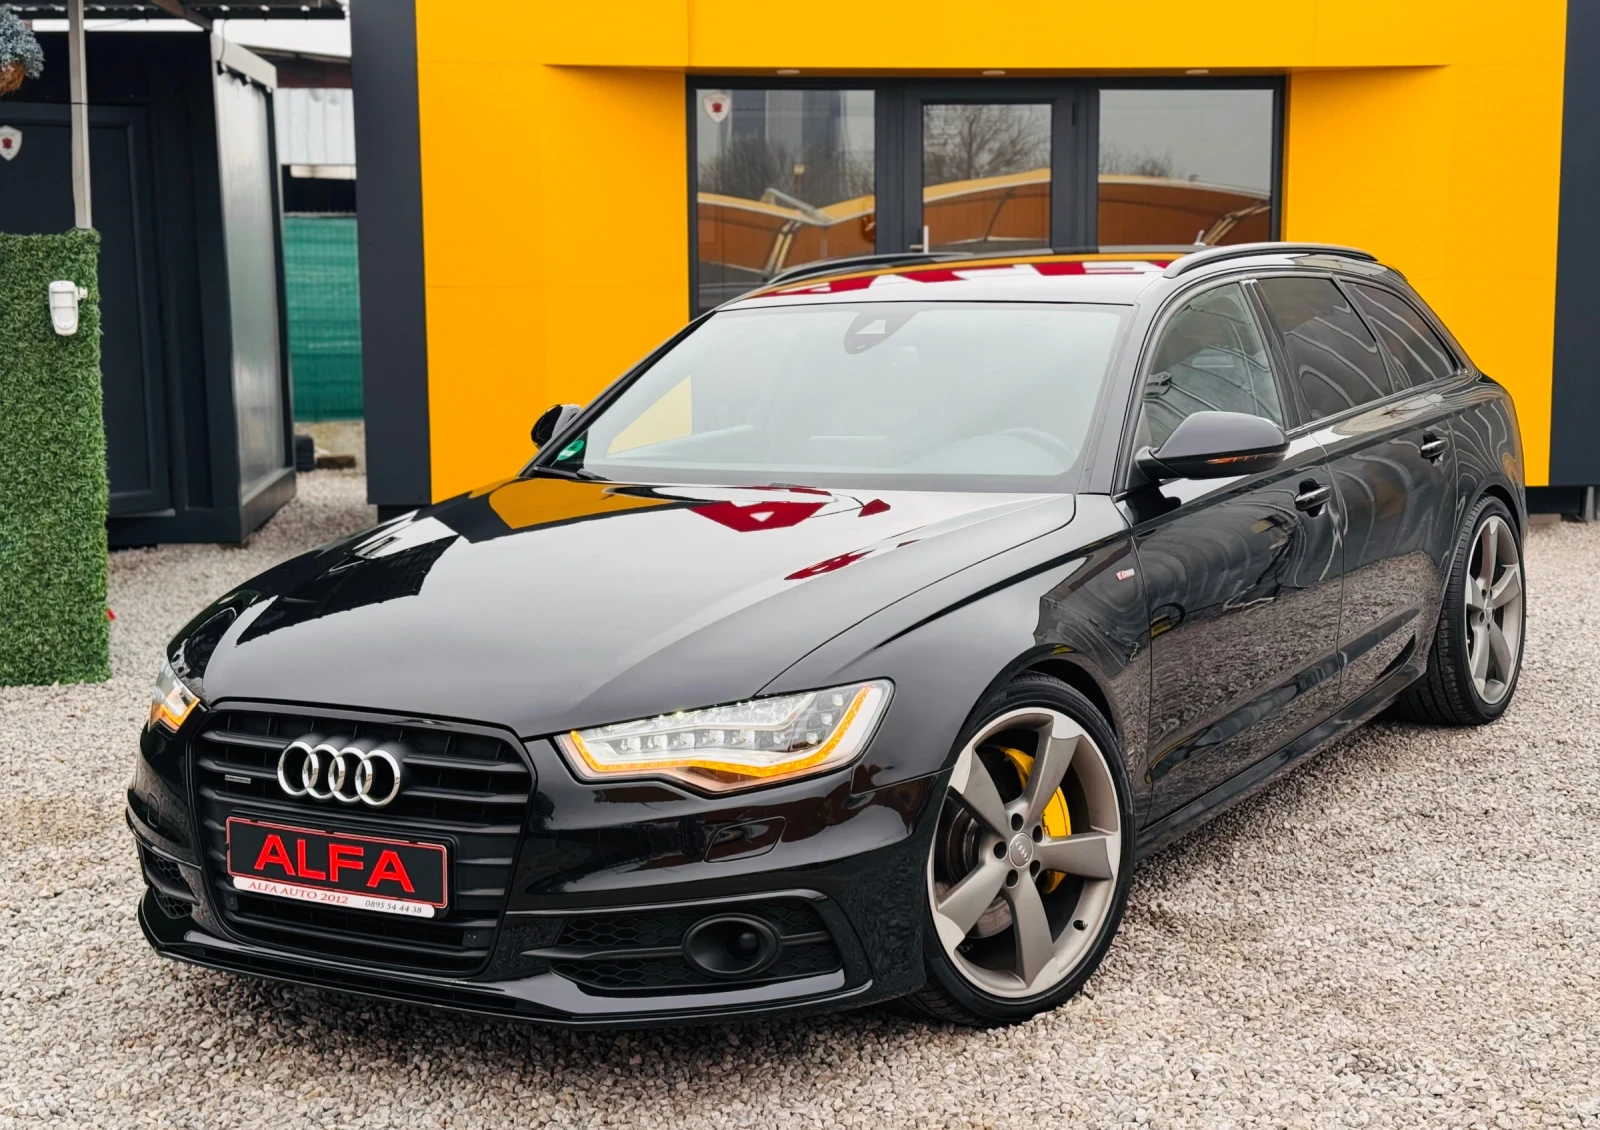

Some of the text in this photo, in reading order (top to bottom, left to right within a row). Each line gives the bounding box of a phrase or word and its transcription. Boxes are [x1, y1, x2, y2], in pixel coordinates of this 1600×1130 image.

[254, 834, 415, 893] ALFA
[248, 881, 349, 904] ALFA AUTO 2012
[365, 900, 422, 914] 0895 54 44 38
